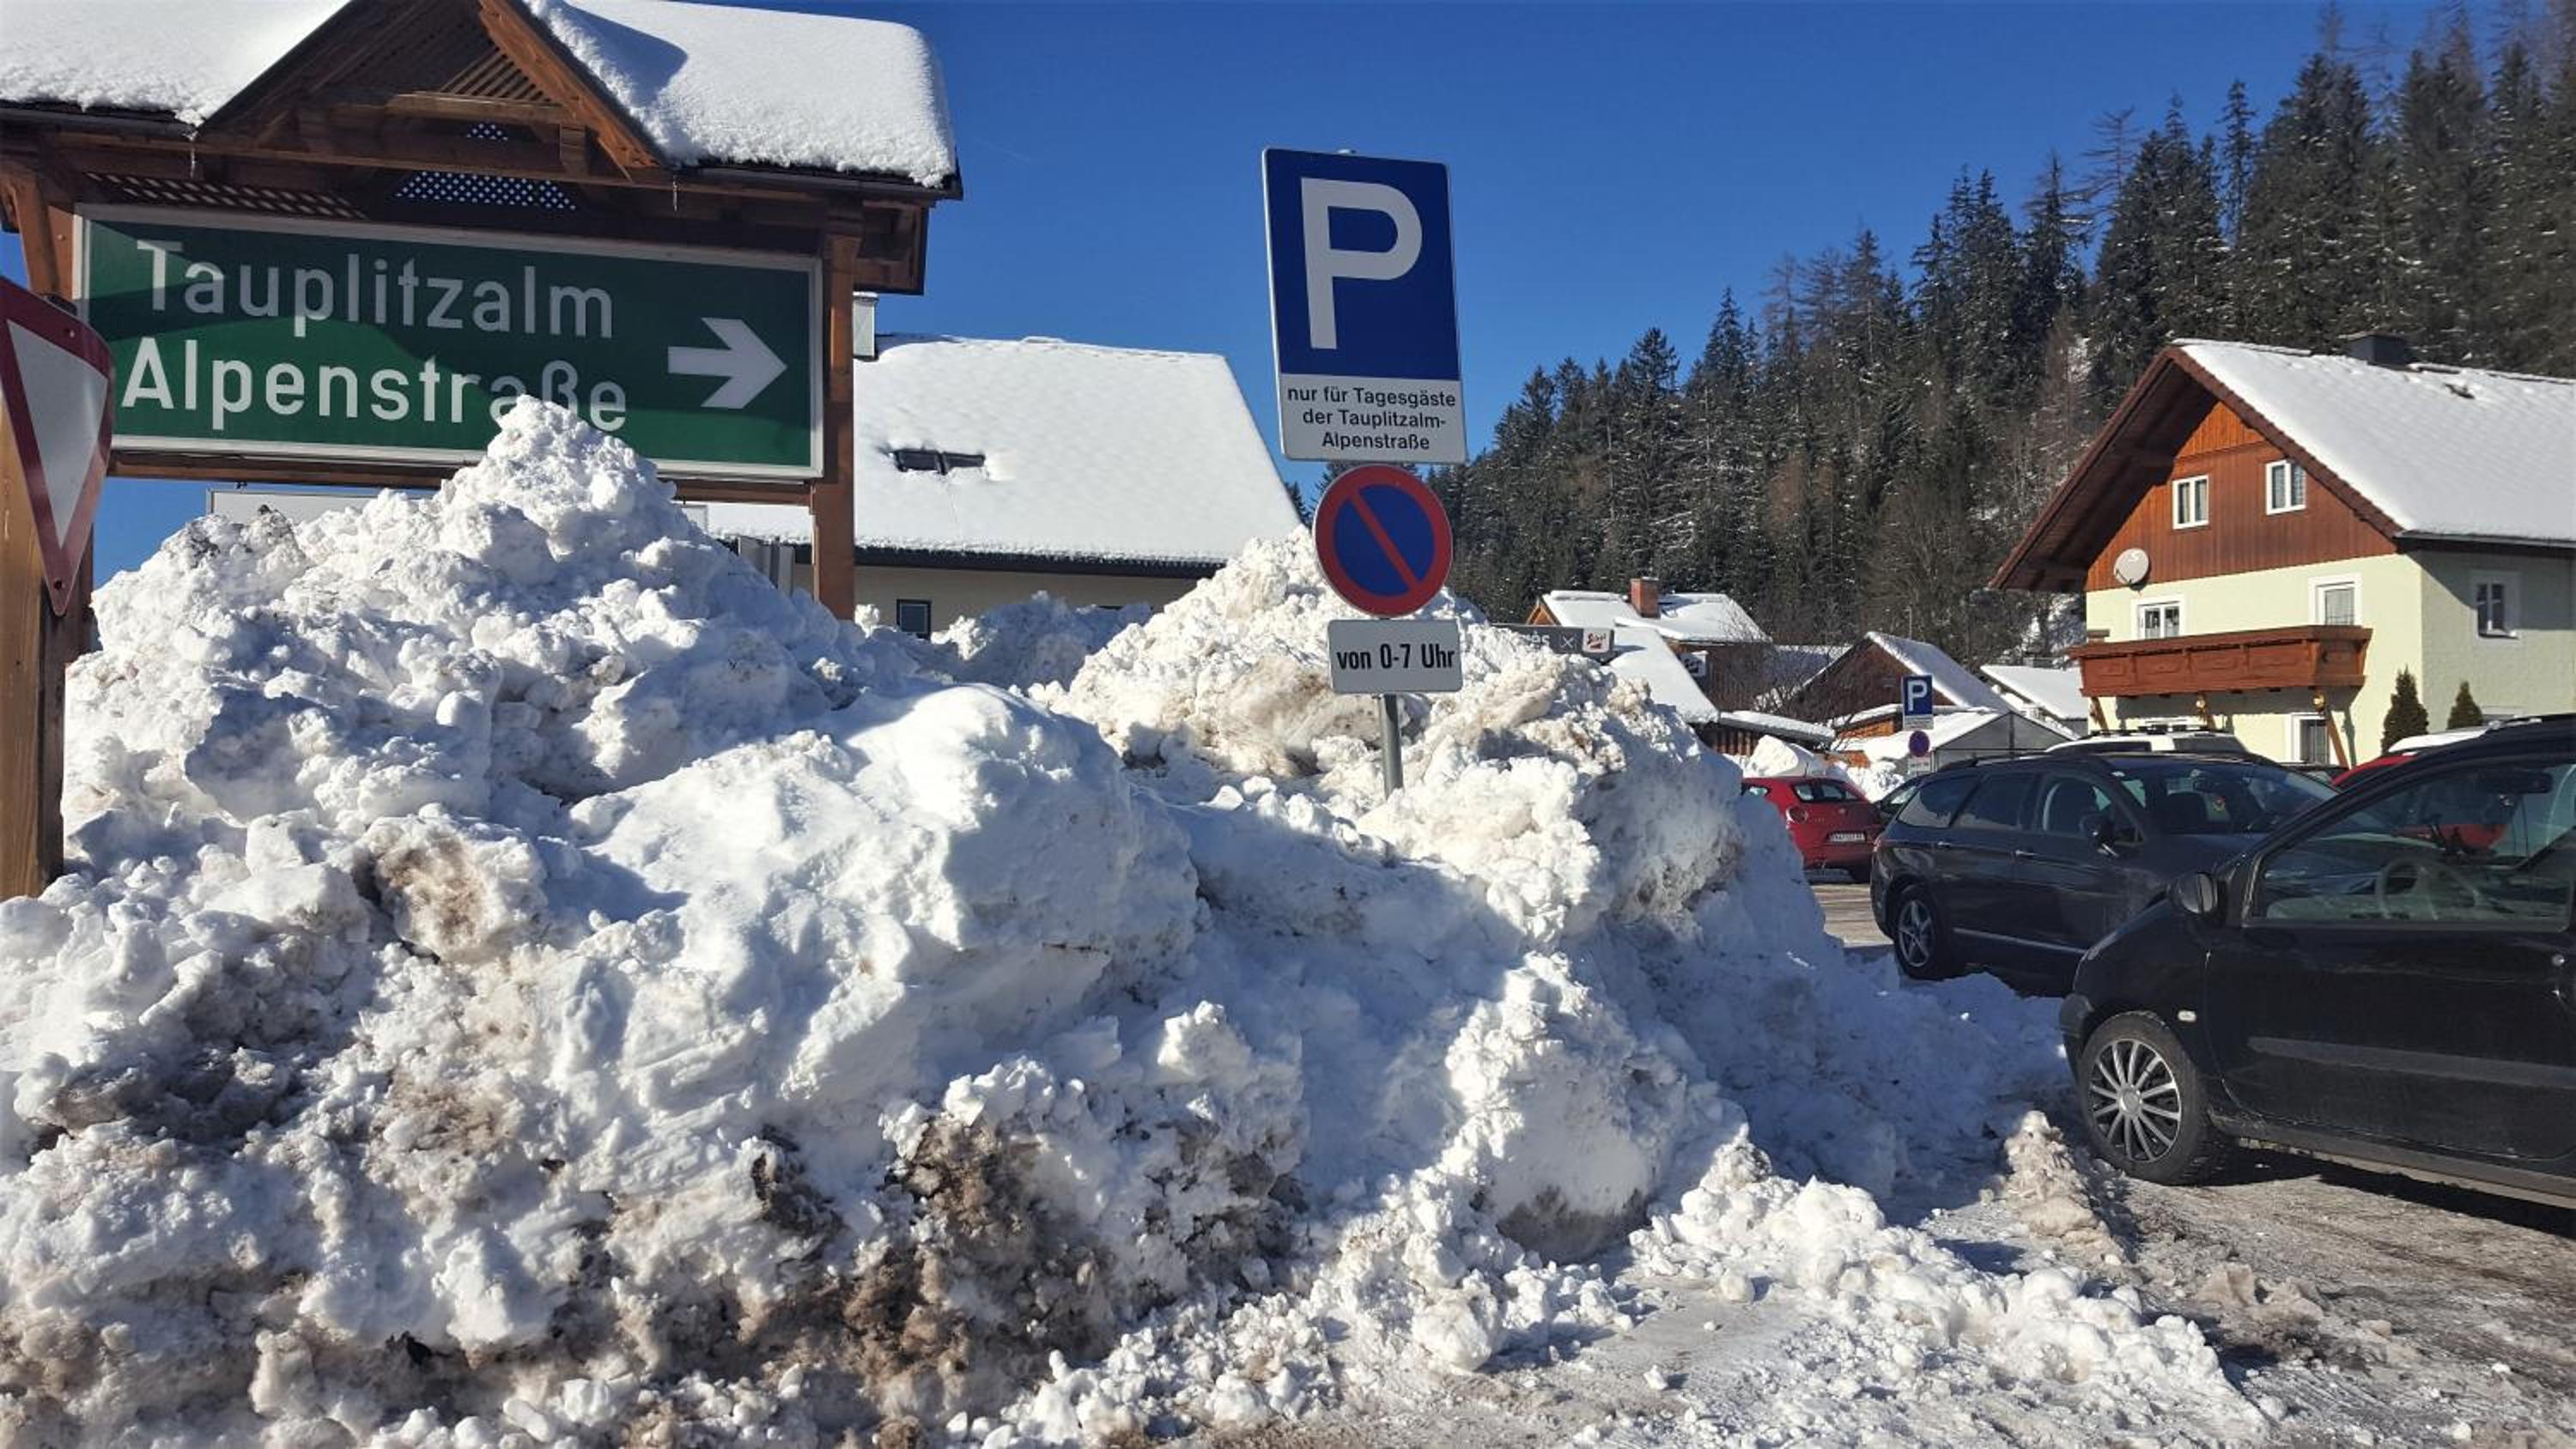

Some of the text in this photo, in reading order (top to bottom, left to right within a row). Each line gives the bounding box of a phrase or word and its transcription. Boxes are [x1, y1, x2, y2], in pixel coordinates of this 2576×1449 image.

[1300, 176, 1423, 350] P
[136, 239, 614, 338] Tauplitzalm
[120, 337, 627, 432] Alpenstraße
[1287, 385, 1456, 409] nur für Tagesgäste
[1303, 409, 1447, 429] der Tauplitzalm-
[1321, 432, 1431, 451] Alpenstraße
[1337, 643, 1455, 670] von 0-7 Uhr
[1906, 679, 1929, 712] P
